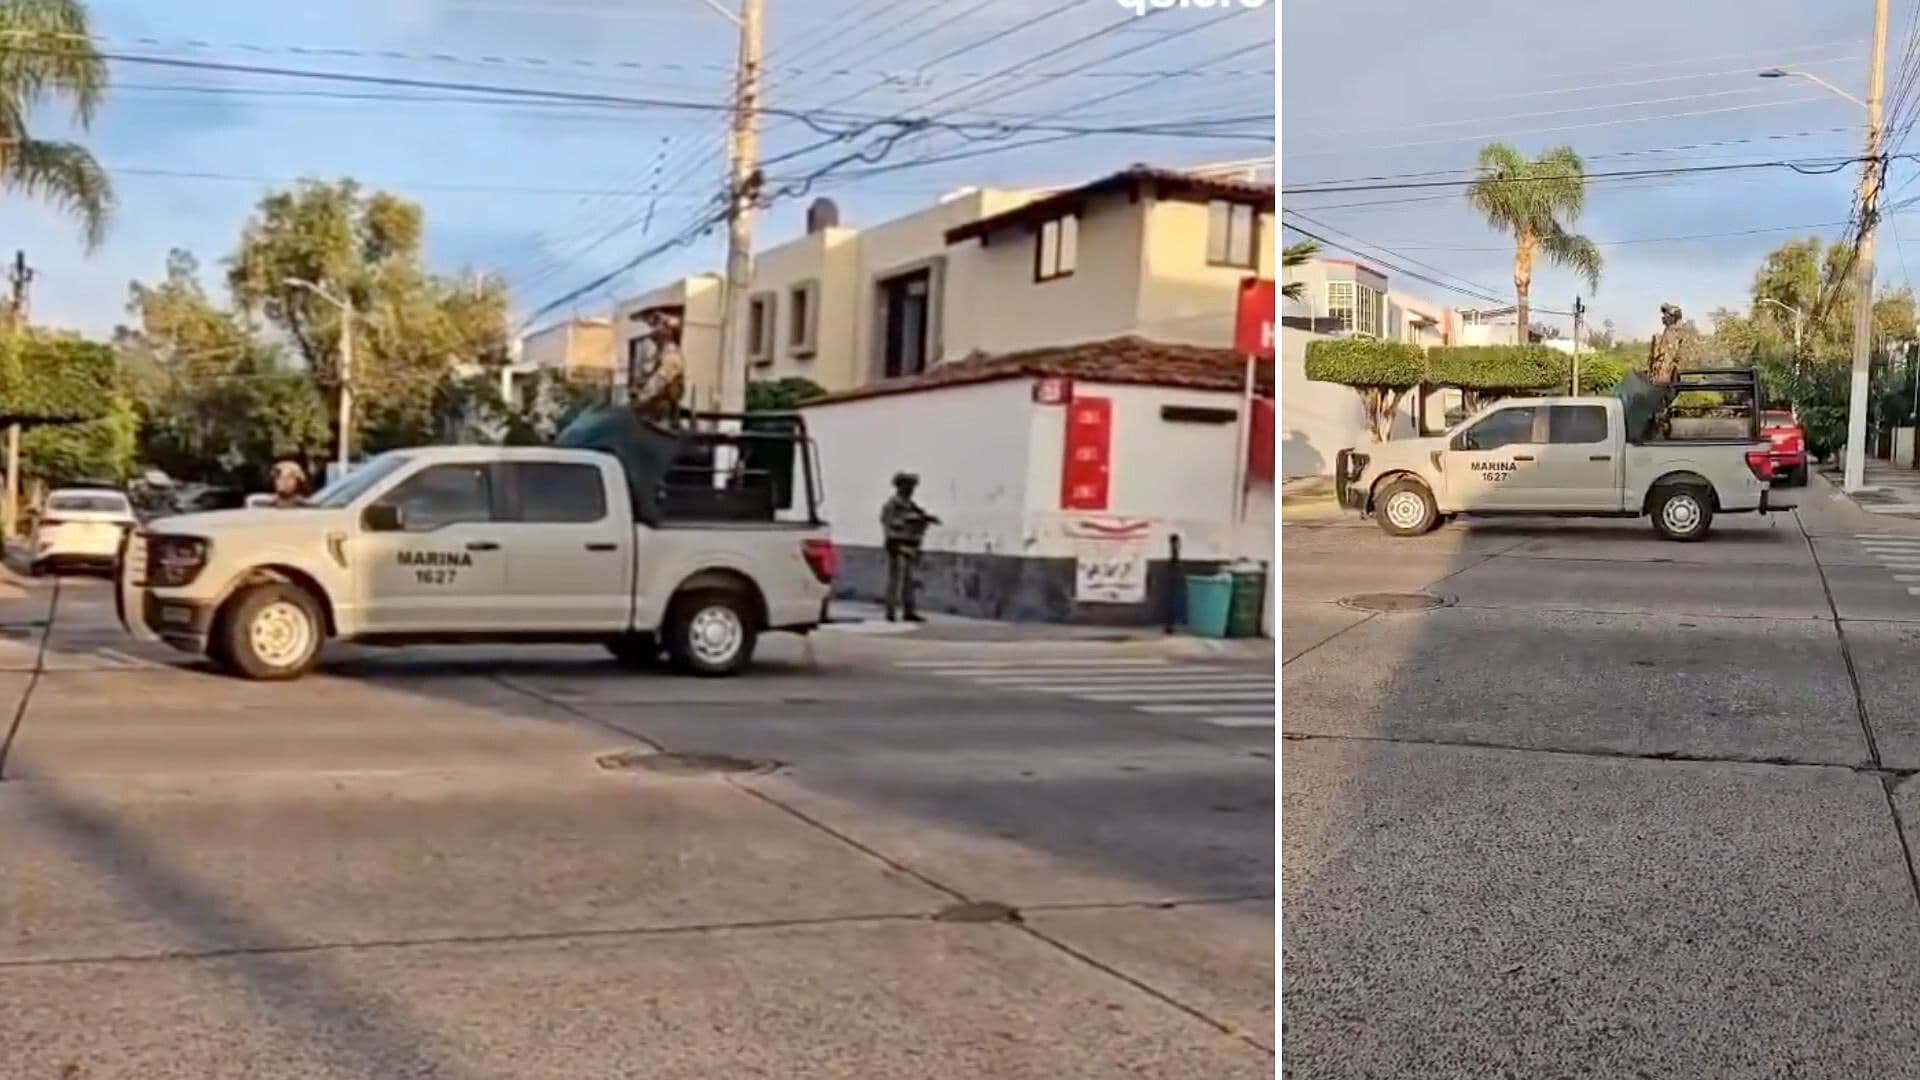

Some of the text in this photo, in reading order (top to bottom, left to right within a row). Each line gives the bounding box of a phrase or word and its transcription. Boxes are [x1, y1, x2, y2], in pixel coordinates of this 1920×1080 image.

[1471, 461, 1517, 471] MARINA
[1482, 472, 1508, 481] 1627
[397, 551, 473, 567] MARINA
[415, 569, 457, 585] 1627
